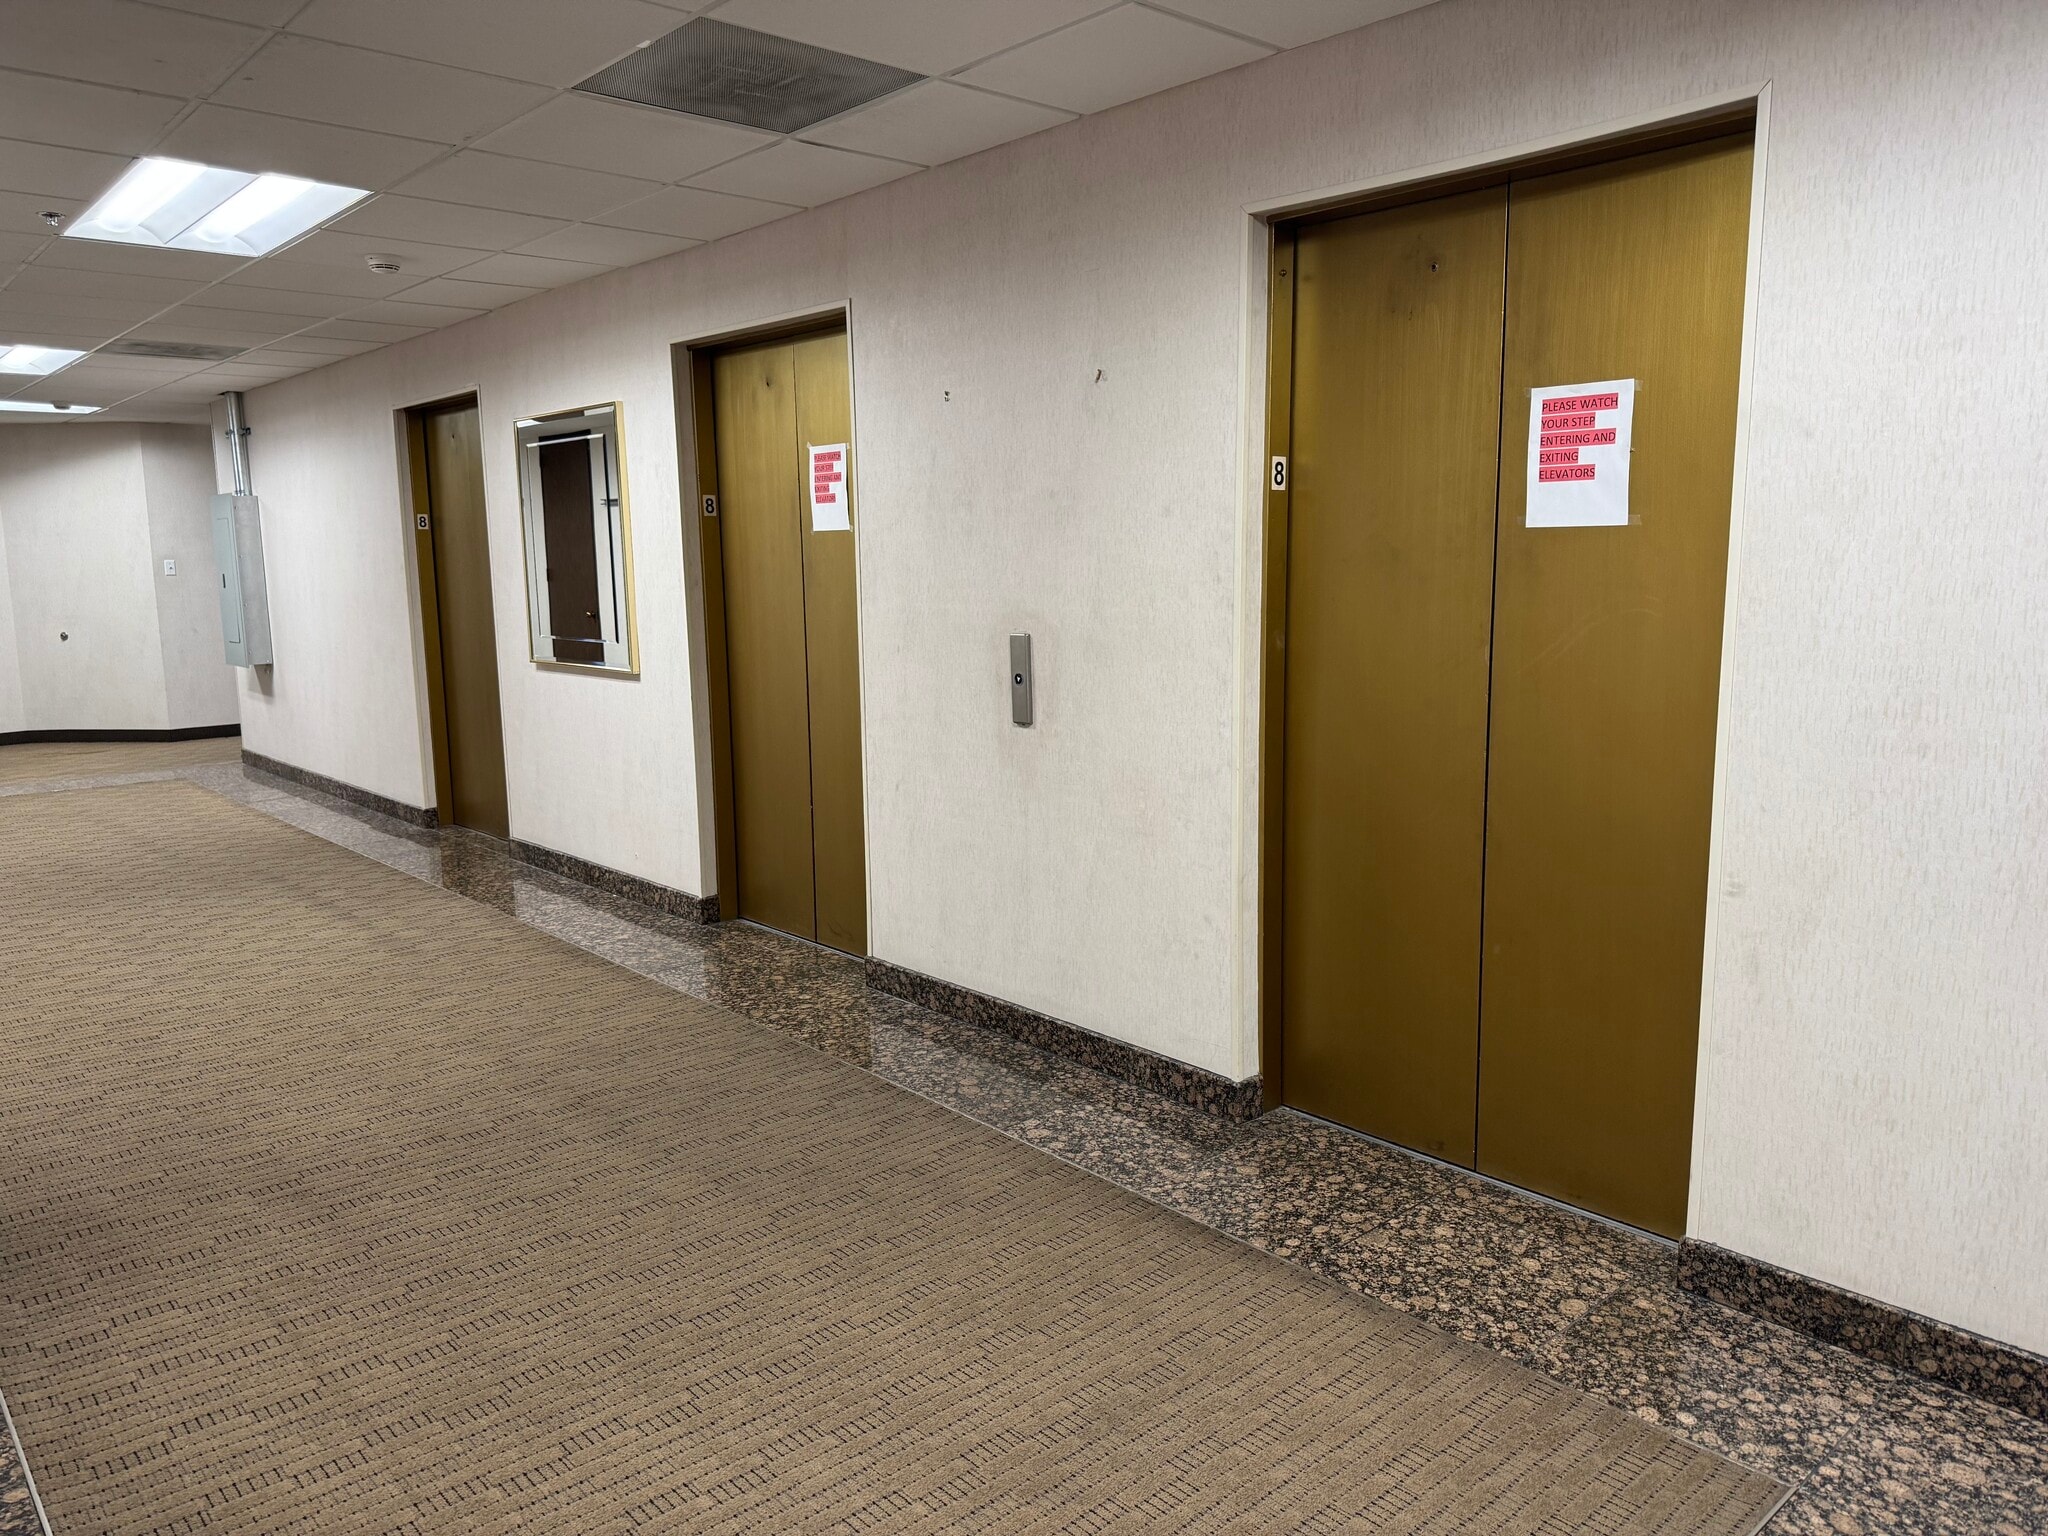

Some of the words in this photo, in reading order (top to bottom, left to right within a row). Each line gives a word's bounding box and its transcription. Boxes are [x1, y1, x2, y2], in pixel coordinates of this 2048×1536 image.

[1542, 399, 1577, 412] PLEASE
[1580, 396, 1618, 409] WATCH
[1541, 417, 1569, 429] YOUR
[1572, 415, 1596, 427] STEP
[1540, 433, 1590, 446] ENTERING
[1593, 431, 1616, 443] AND
[1539, 450, 1579, 463] EXITING
[1274, 461, 1284, 486] 8
[1539, 467, 1595, 480] ELEVATORS
[705, 497, 715, 514] 8
[419, 516, 427, 528] 8
